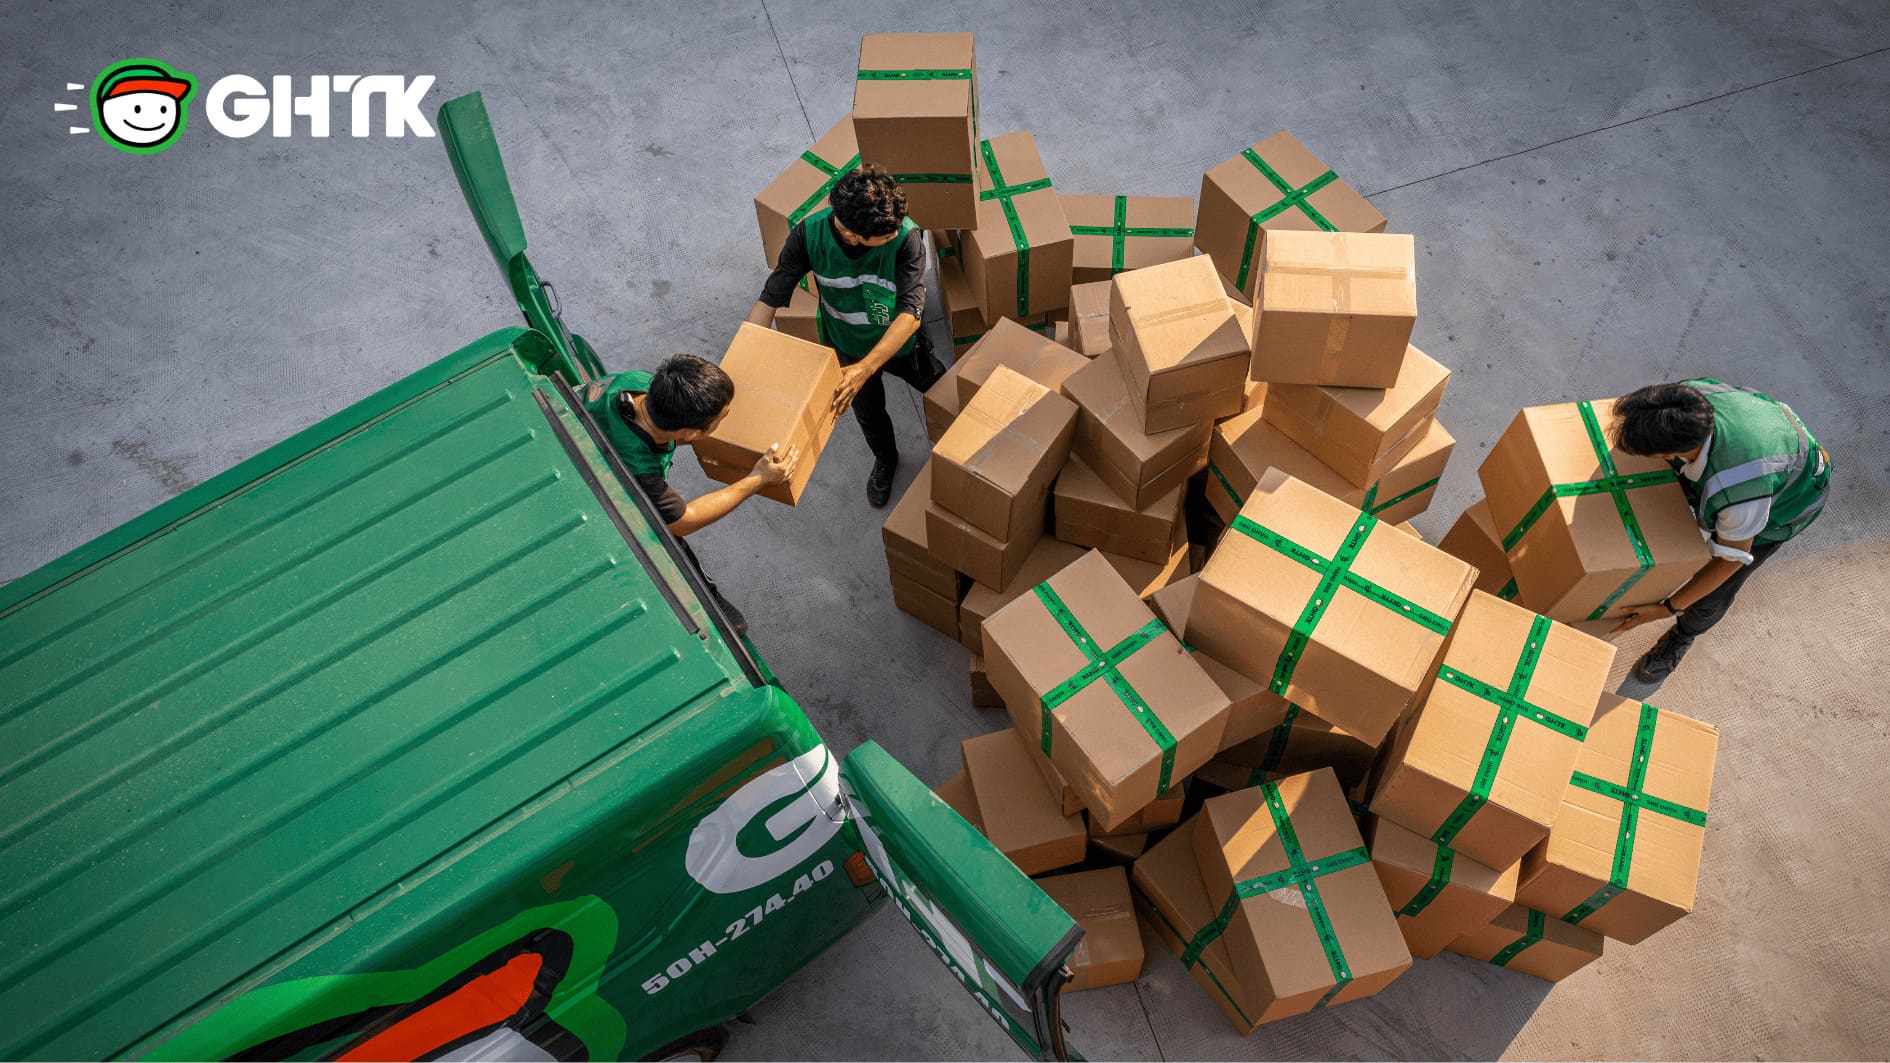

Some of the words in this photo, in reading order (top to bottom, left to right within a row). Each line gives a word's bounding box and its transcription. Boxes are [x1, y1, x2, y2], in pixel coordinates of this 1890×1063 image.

[1347, 531, 1362, 550] GHTK
[1304, 605, 1319, 624] GHTK
[640, 859, 834, 995] 50H-274.40
